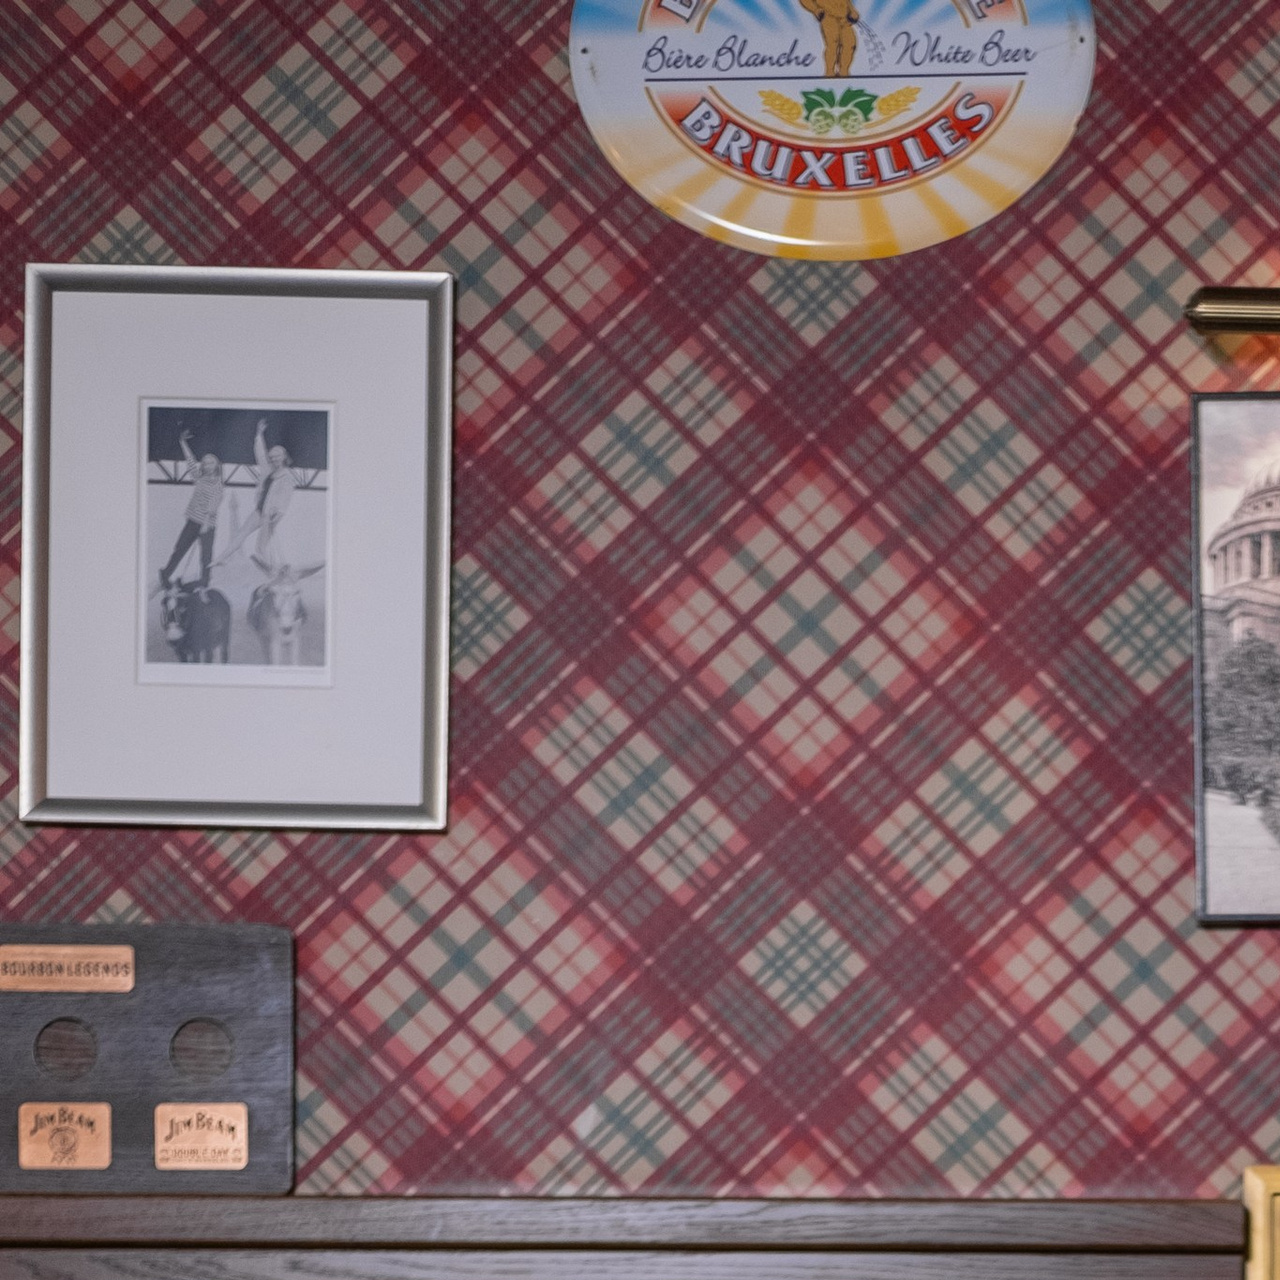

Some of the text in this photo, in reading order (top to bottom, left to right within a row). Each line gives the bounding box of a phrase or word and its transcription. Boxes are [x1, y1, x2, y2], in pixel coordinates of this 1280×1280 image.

[642, 34, 817, 73] Bière Blanche
[891, 29, 1037, 67] White Beer
[679, 92, 995, 188] BRUXELLES
